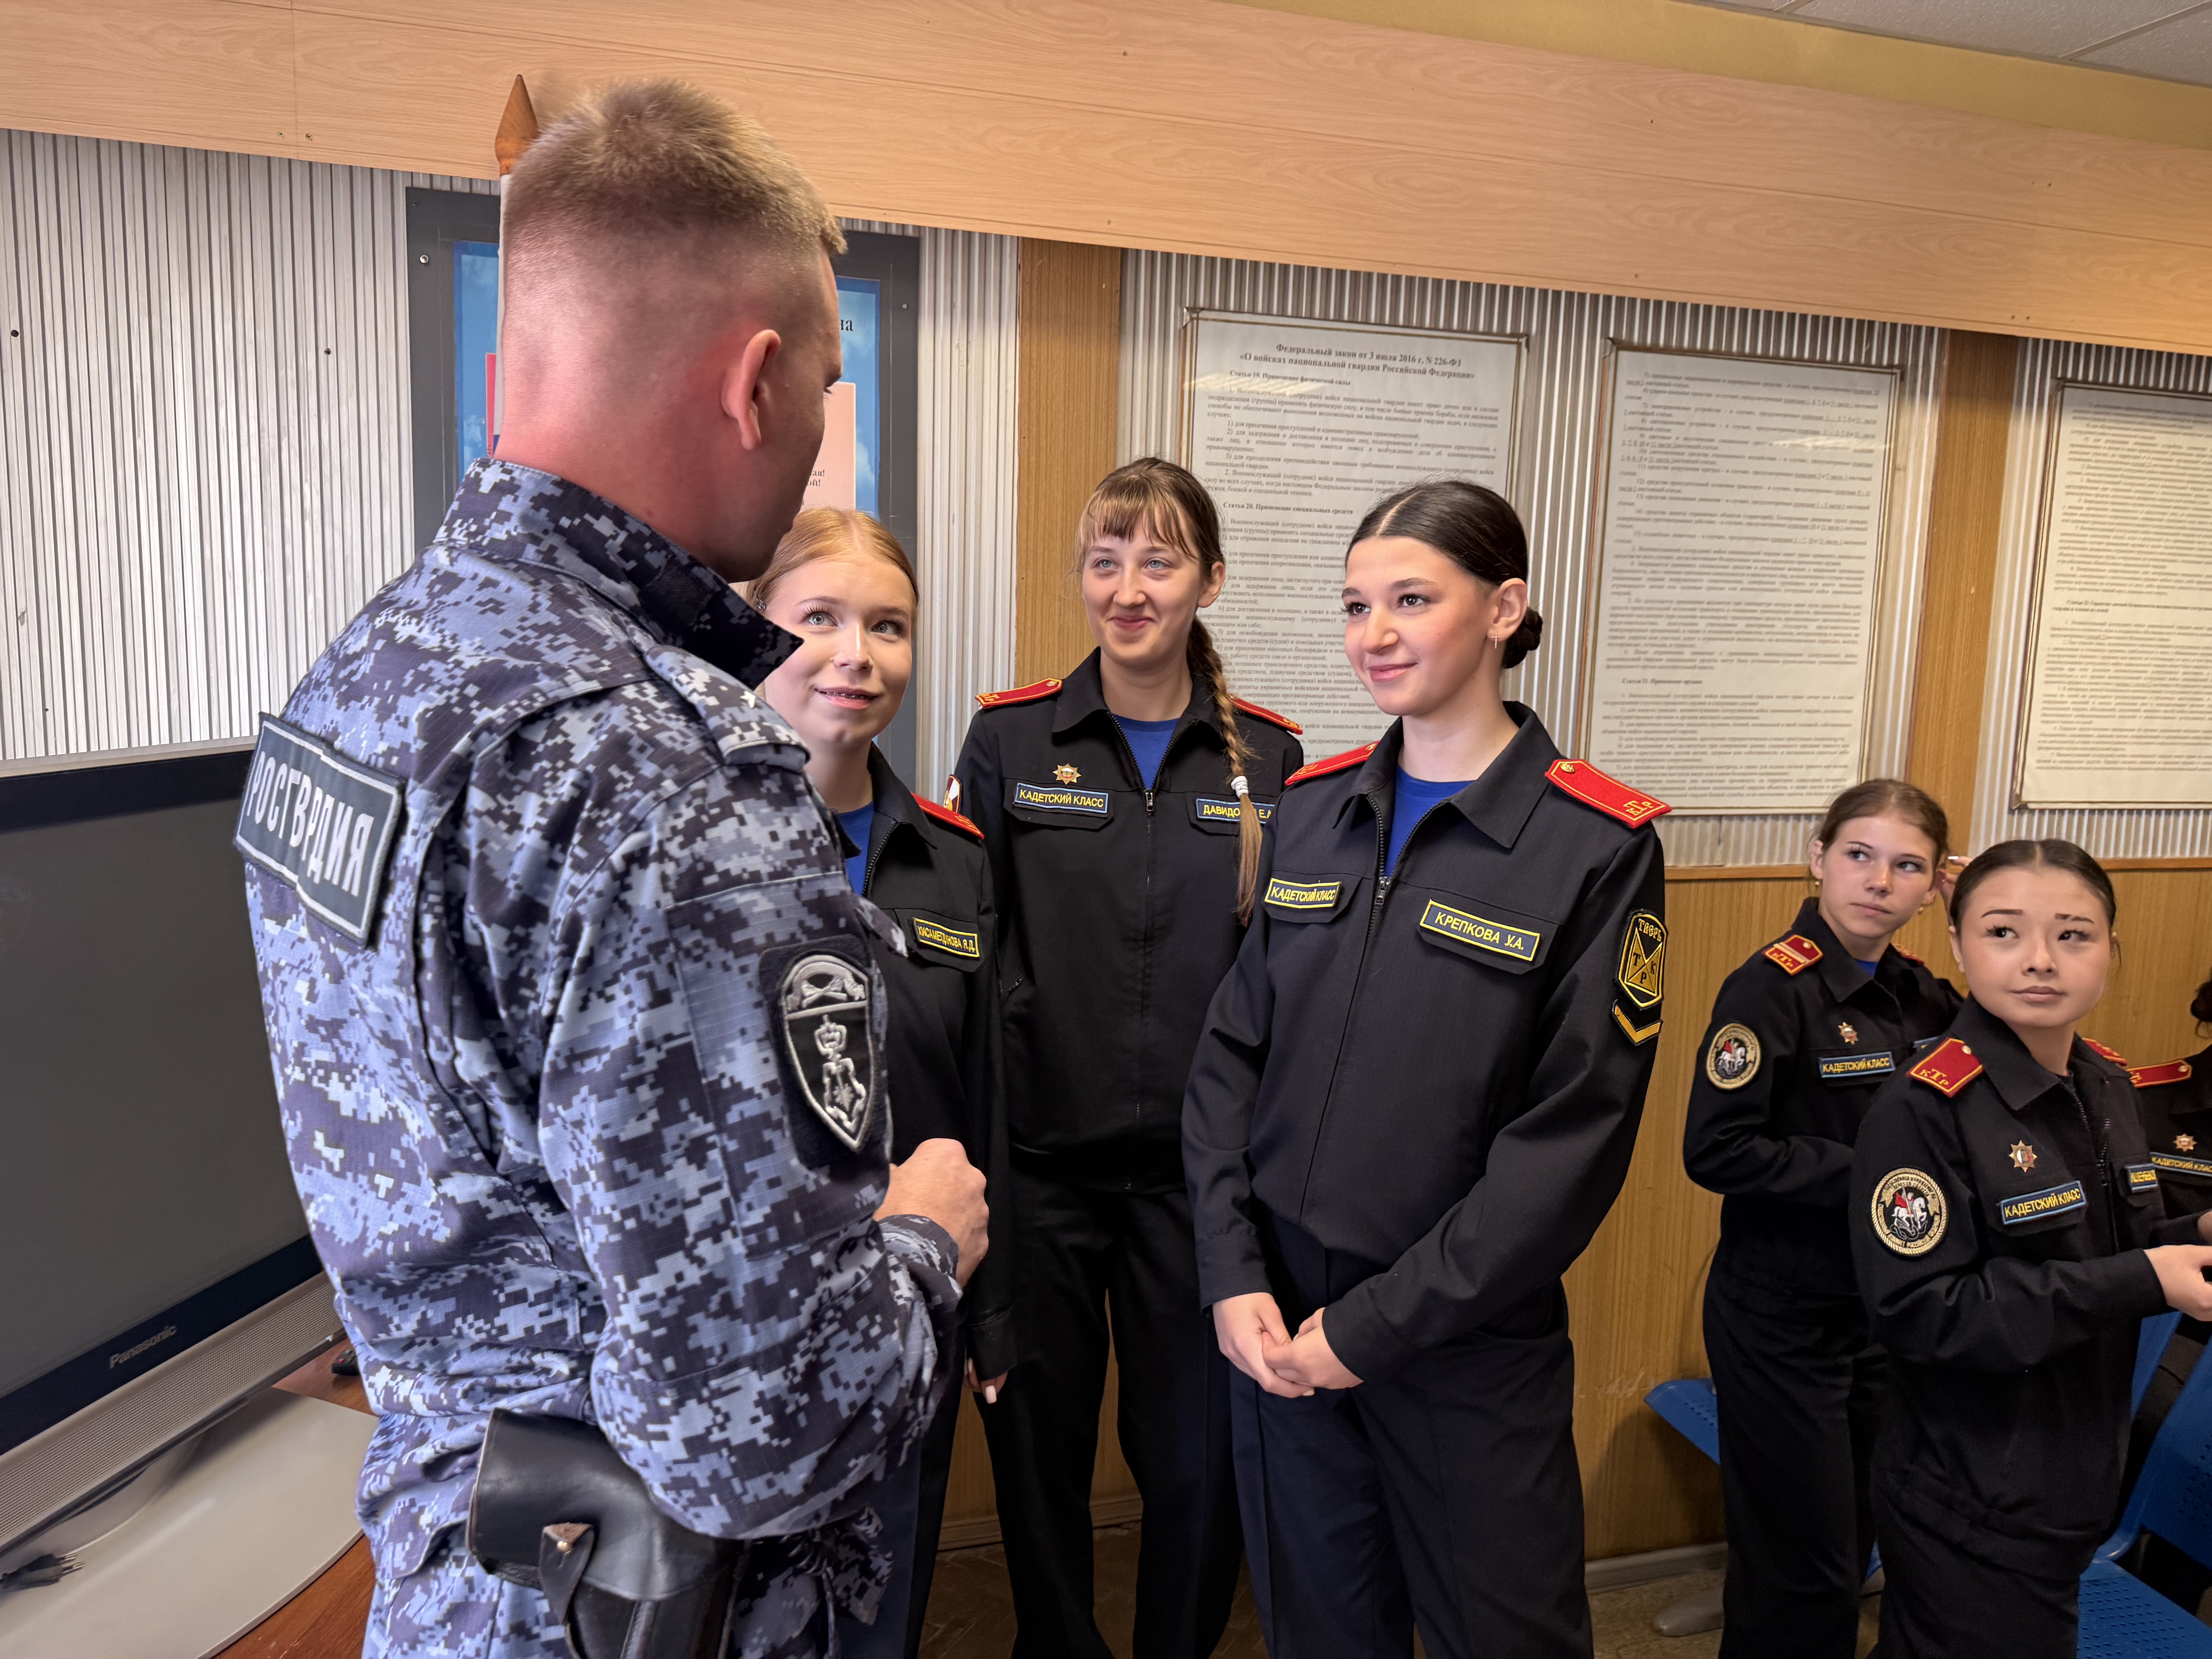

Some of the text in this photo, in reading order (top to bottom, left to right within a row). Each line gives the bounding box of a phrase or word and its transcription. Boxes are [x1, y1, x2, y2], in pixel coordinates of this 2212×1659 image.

[1254, 354, 1285, 363] войсках
[1288, 358, 1345, 368] национальной
[1348, 363, 1379, 371] гвардии
[1382, 364, 1426, 374] Российской
[1276, 343, 1331, 356] Федеральный
[1399, 354, 1415, 363] 2016
[1434, 357, 1461, 367] 226-ФЗ
[1019, 789, 1104, 808] КАДЕТСКИЙ КЛАСС
[1203, 804, 1257, 818] ДАВИДО
[1271, 886, 1336, 902] КАДЕТСКИЙ КЛАСС
[1434, 911, 1524, 950] КРЕПКОВА У.А.
[1638, 918, 1662, 942] ТВЕРЬ
[1822, 1057, 1890, 1073] КАДЕТСКИЙ КЛАСС
[2152, 1156, 2212, 1173] КАДЕТСКИЙ КЛАС
[2004, 1188, 2081, 1218] КАДЕТСКИЙ КЛАСС
[110, 1325, 177, 1369] Panasonic
